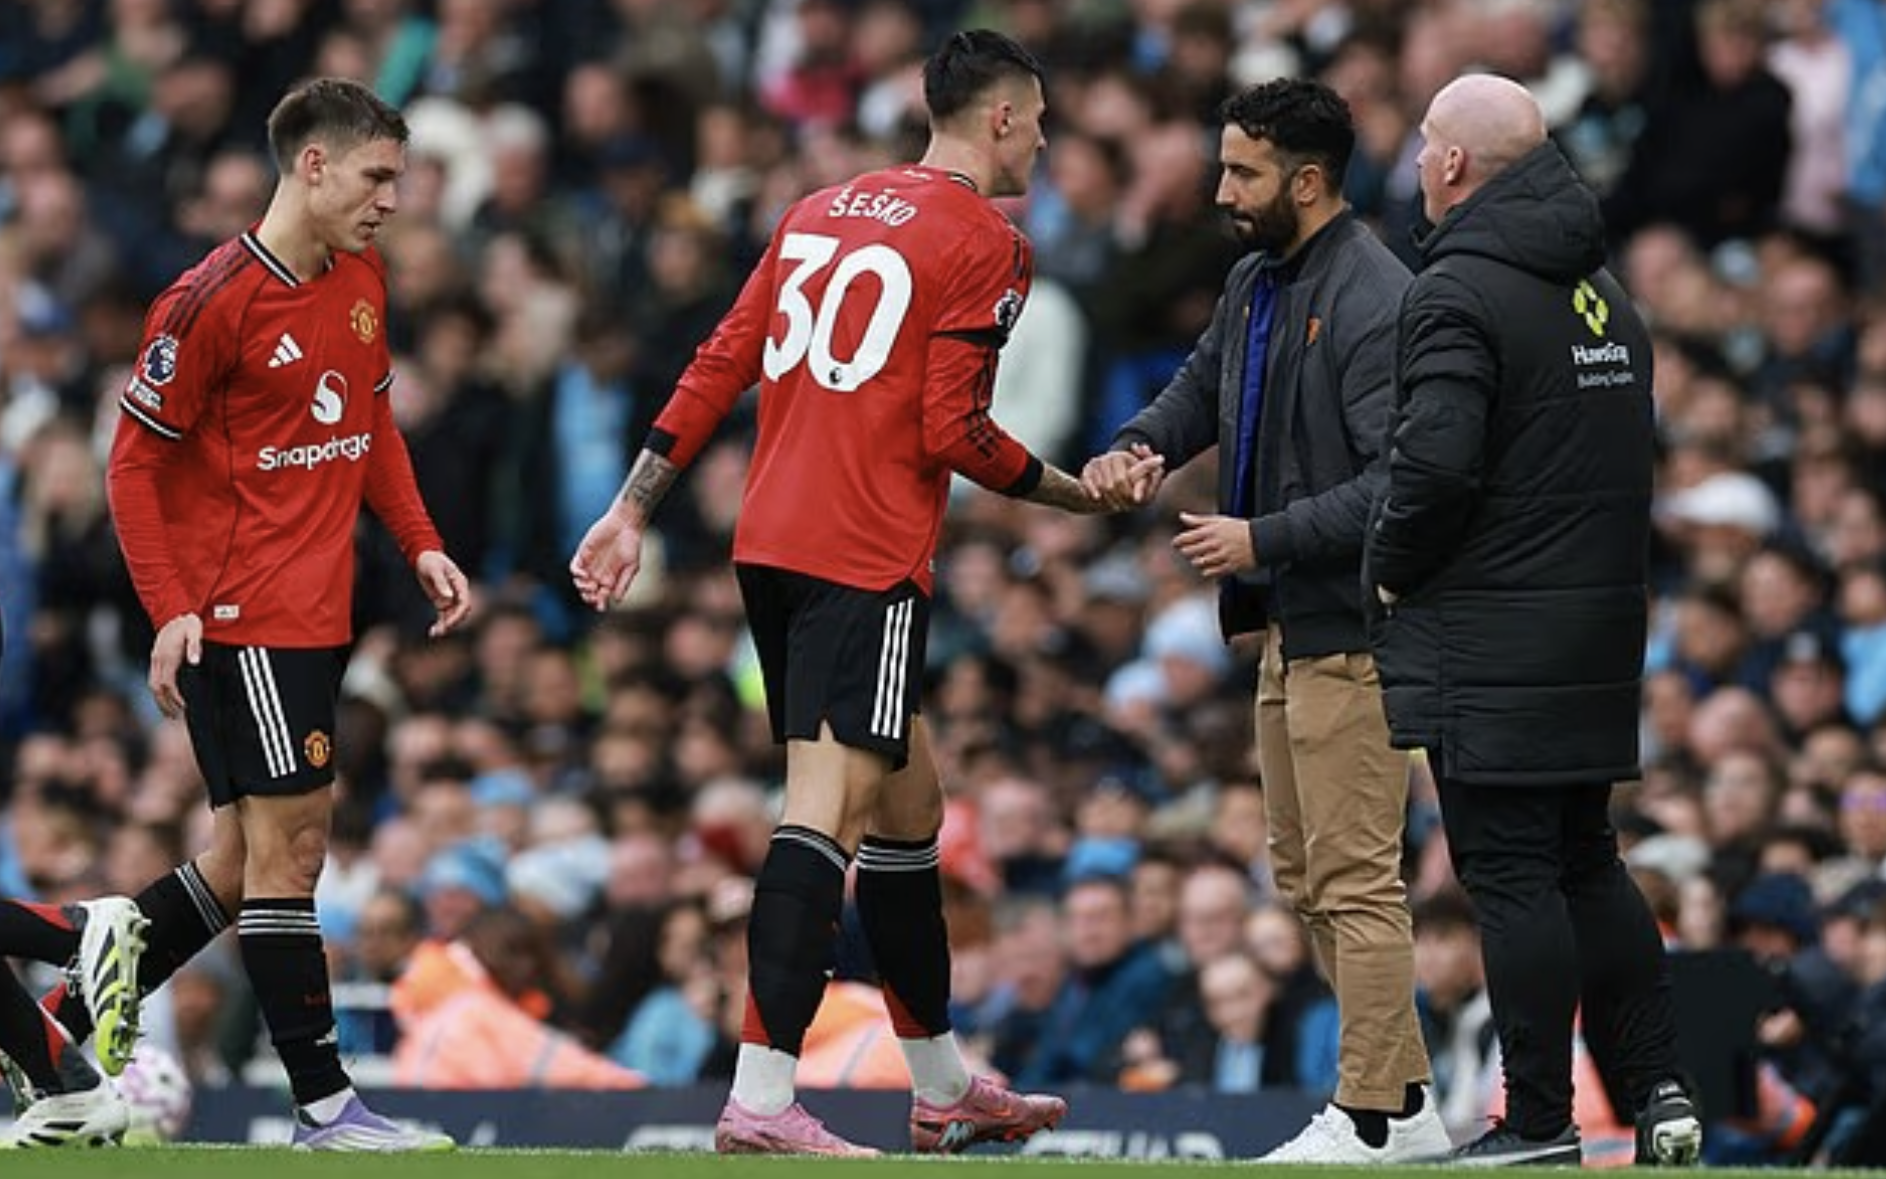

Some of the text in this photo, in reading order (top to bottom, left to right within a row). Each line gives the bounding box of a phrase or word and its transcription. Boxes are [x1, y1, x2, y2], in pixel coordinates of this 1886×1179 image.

[828, 186, 917, 226] ŠEŠKO
[763, 233, 913, 392] 30
[256, 432, 371, 470] Snapdrago
